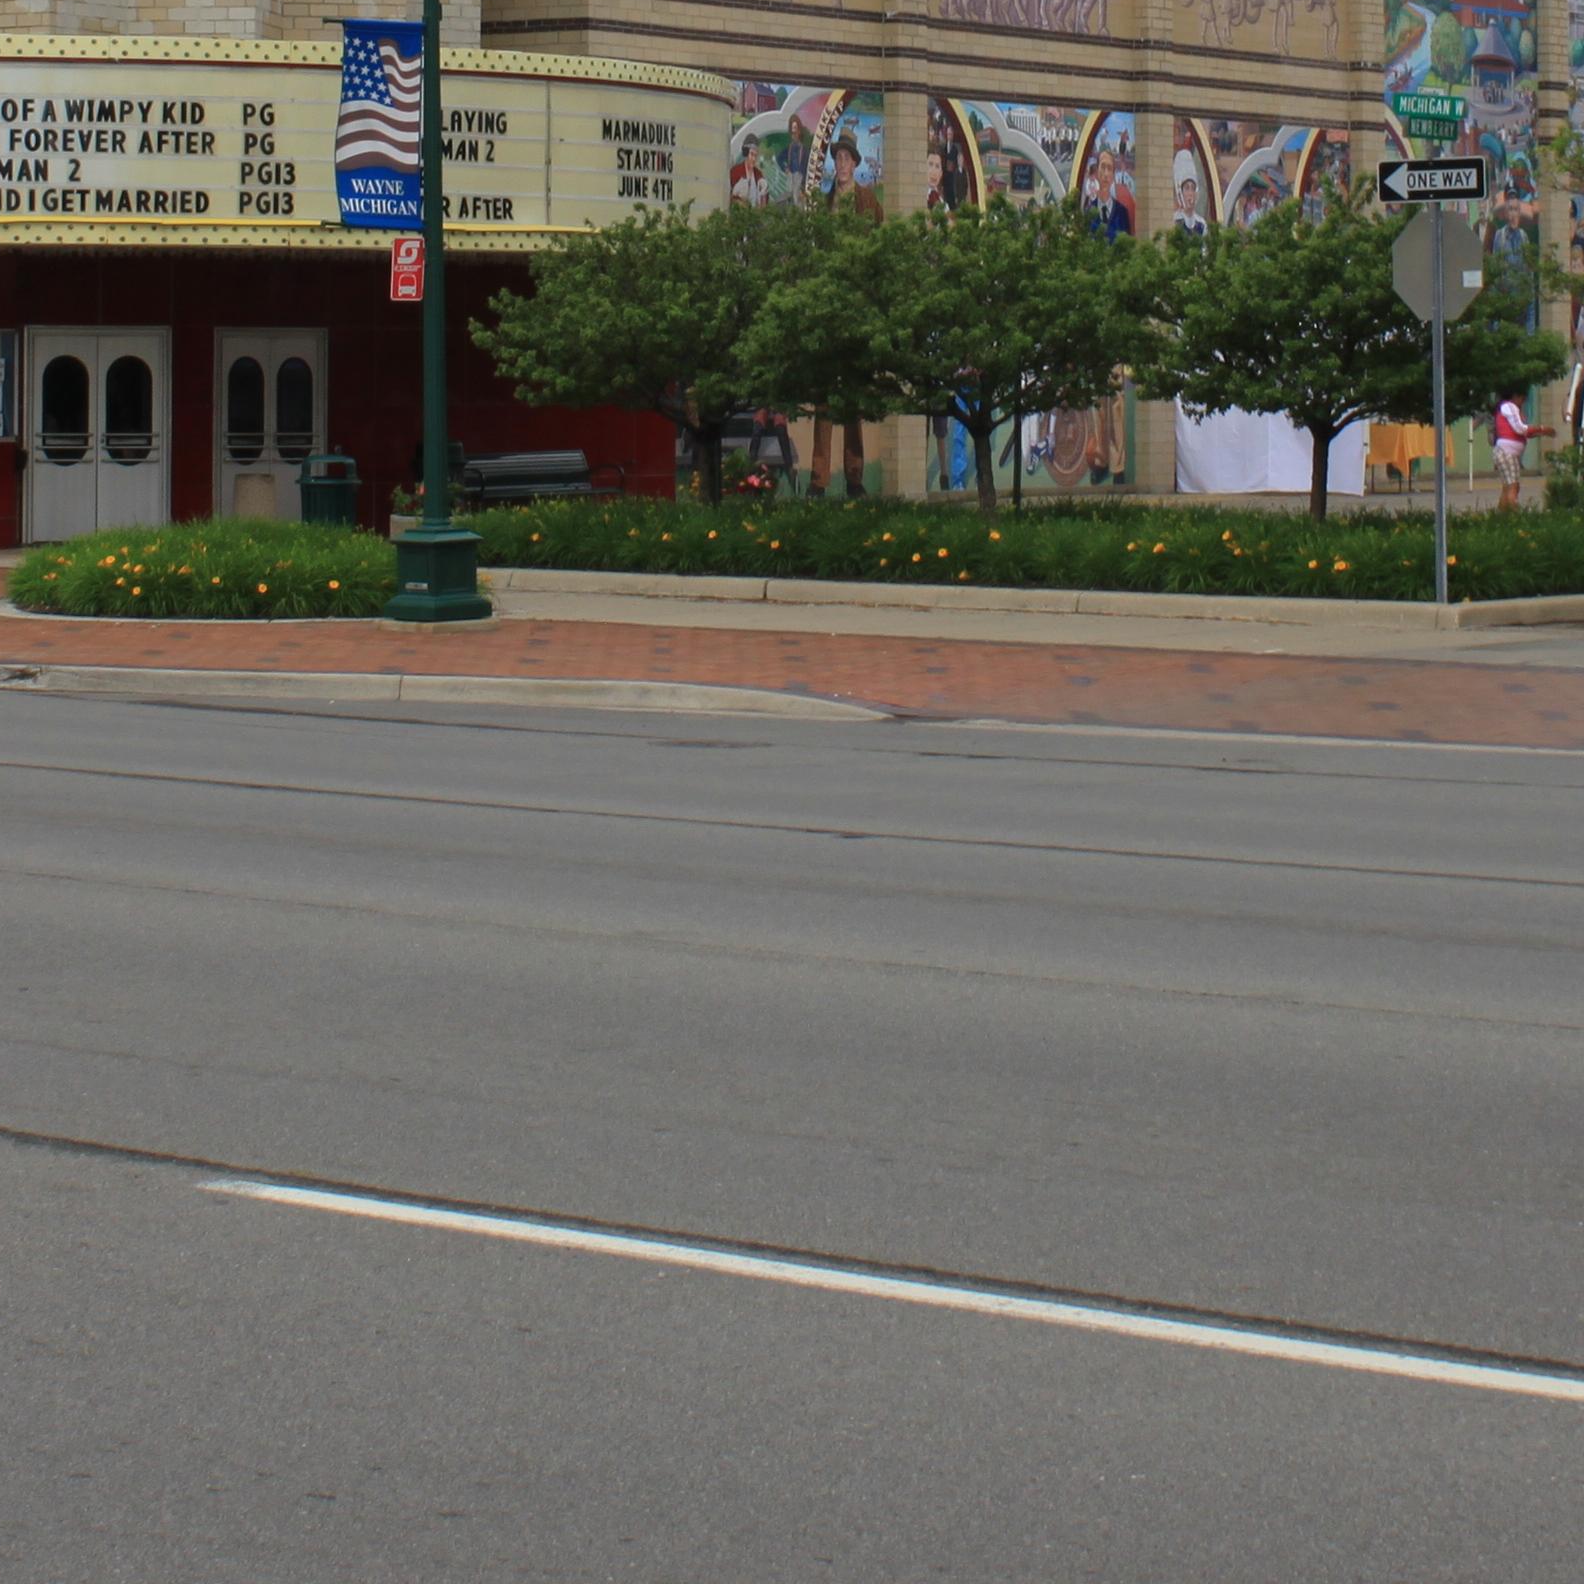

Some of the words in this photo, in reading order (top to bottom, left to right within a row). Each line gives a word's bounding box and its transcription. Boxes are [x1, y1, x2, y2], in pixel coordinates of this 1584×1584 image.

[1, 99, 35, 122] OF
[41, 99, 57, 122] A
[65, 100, 153, 123] WIMPY
[162, 101, 205, 124] KID
[242, 103, 275, 126] PG
[1399, 96, 1451, 115] MICHIGAN
[441, 110, 508, 134] LAYING
[602, 119, 676, 146] MARMADUKE
[1411, 118, 1455, 137] NEWBERRY
[9, 129, 126, 153] FOREVER
[138, 131, 215, 155] AFTER
[244, 133, 275, 156] PG
[441, 139, 479, 162] MAN
[486, 143, 495, 163] 2
[68, 158, 81, 182] 2
[240, 162, 296, 185] PG13
[617, 147, 673, 174] STARTING
[351, 179, 404, 195] WAYNE
[618, 176, 648, 198] JUNE
[652, 179, 673, 202] 4TH
[1407, 173, 1437, 188] ONE
[1442, 171, 1473, 187] WAY
[29, 189, 36, 212] I
[42, 189, 90, 212] GET
[96, 190, 210, 213] MARRIED
[239, 192, 294, 215] PG13
[341, 197, 417, 215] MICHIGAN
[459, 197, 514, 220] AFTER
